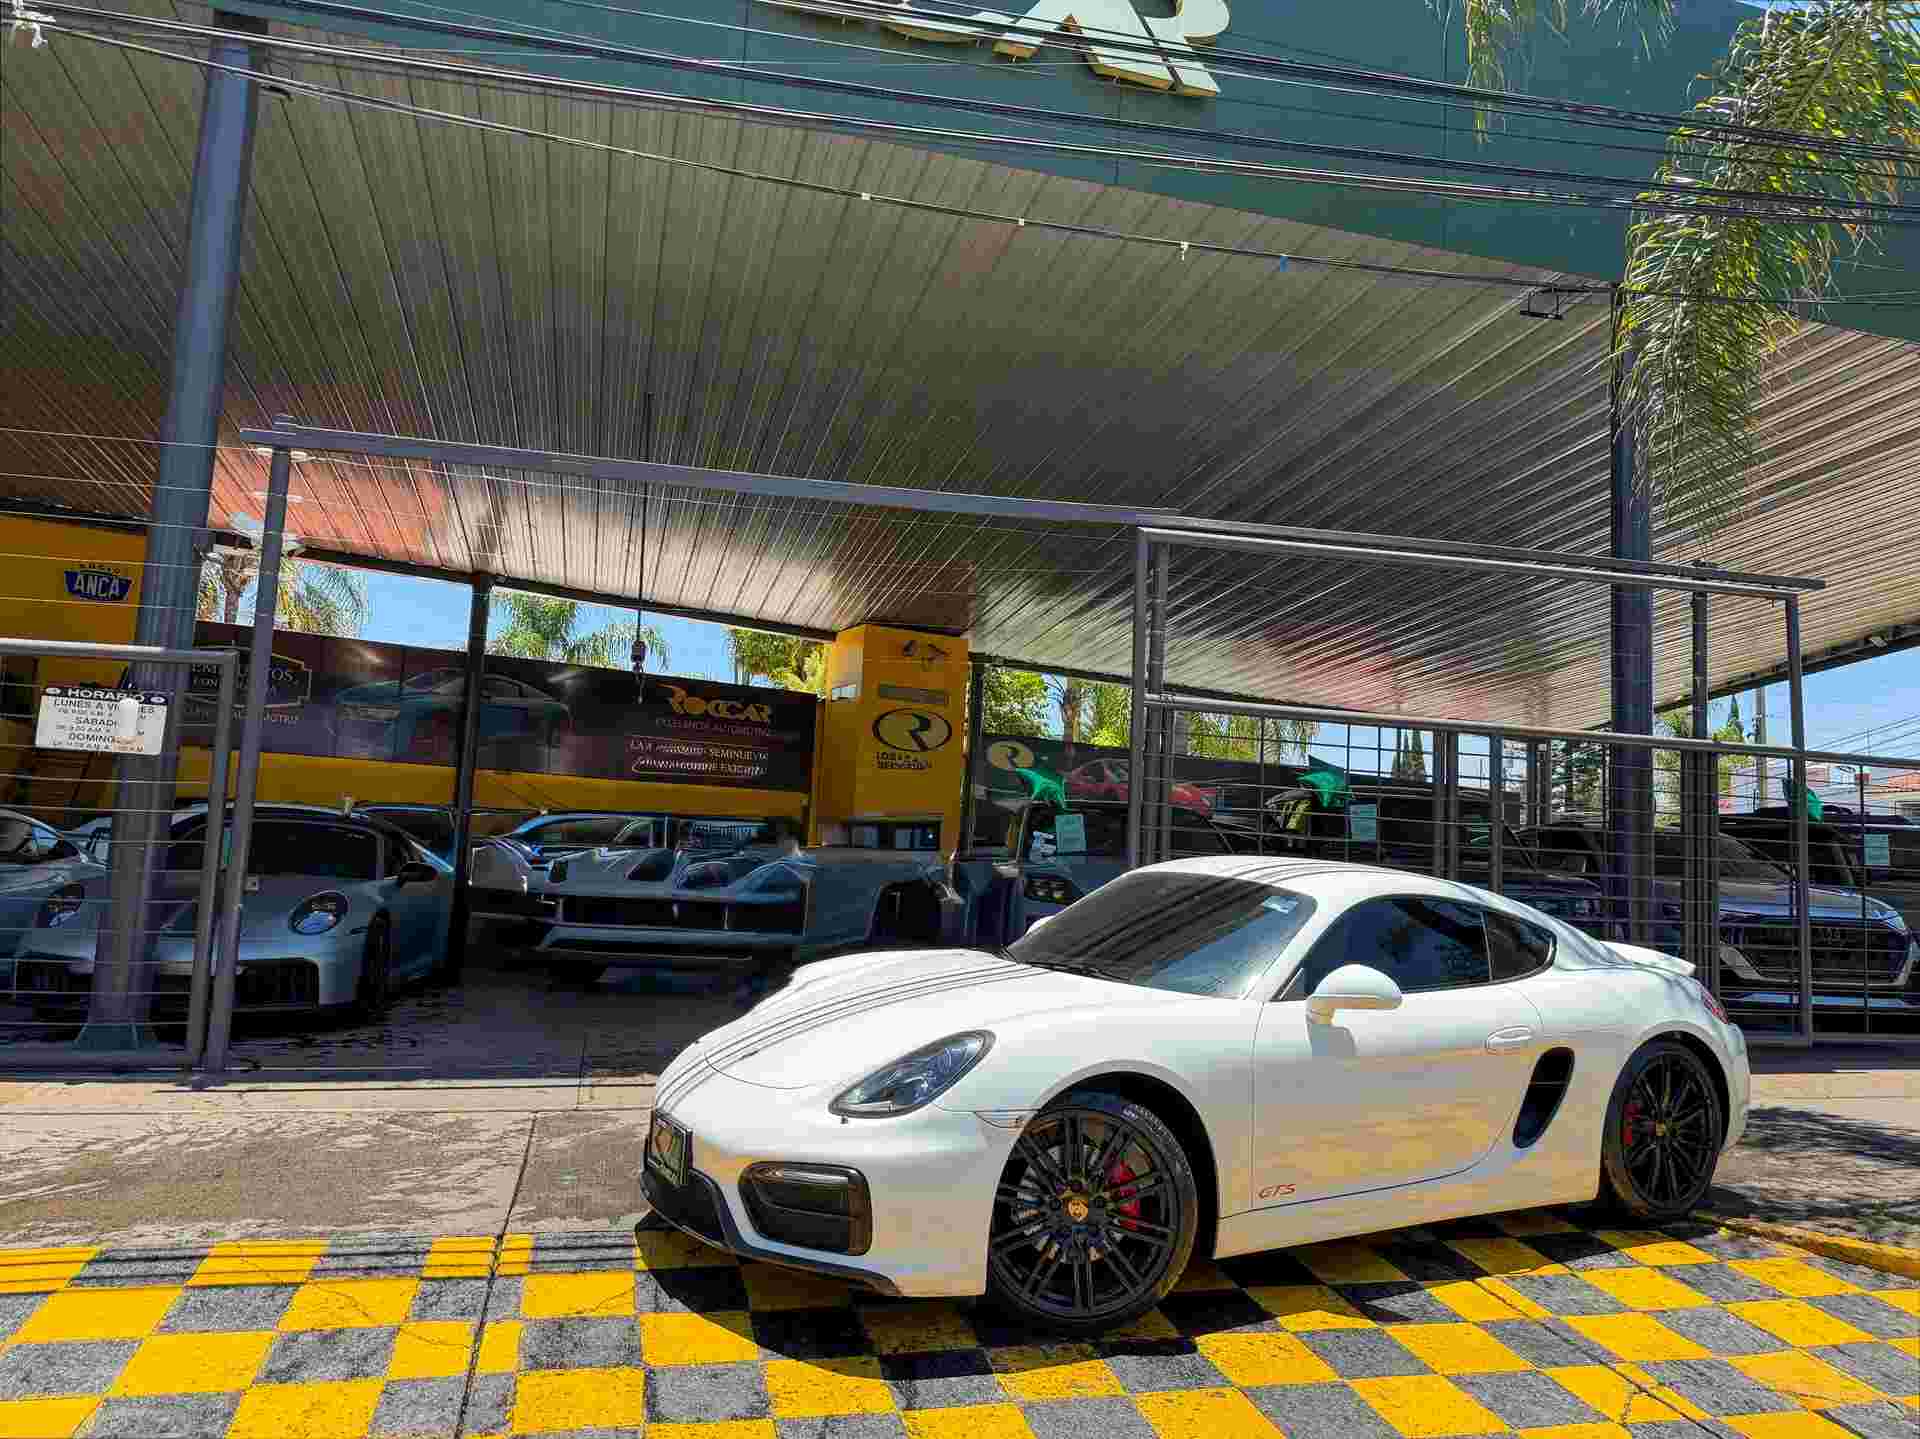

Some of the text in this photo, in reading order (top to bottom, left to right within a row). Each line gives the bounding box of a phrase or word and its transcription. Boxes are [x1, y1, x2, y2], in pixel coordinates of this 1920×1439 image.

[67, 688, 145, 703] HORARO
[54, 698, 93, 709] LUNES
[75, 717, 120, 728] SABAD
[1258, 1184, 1296, 1200] GTS
